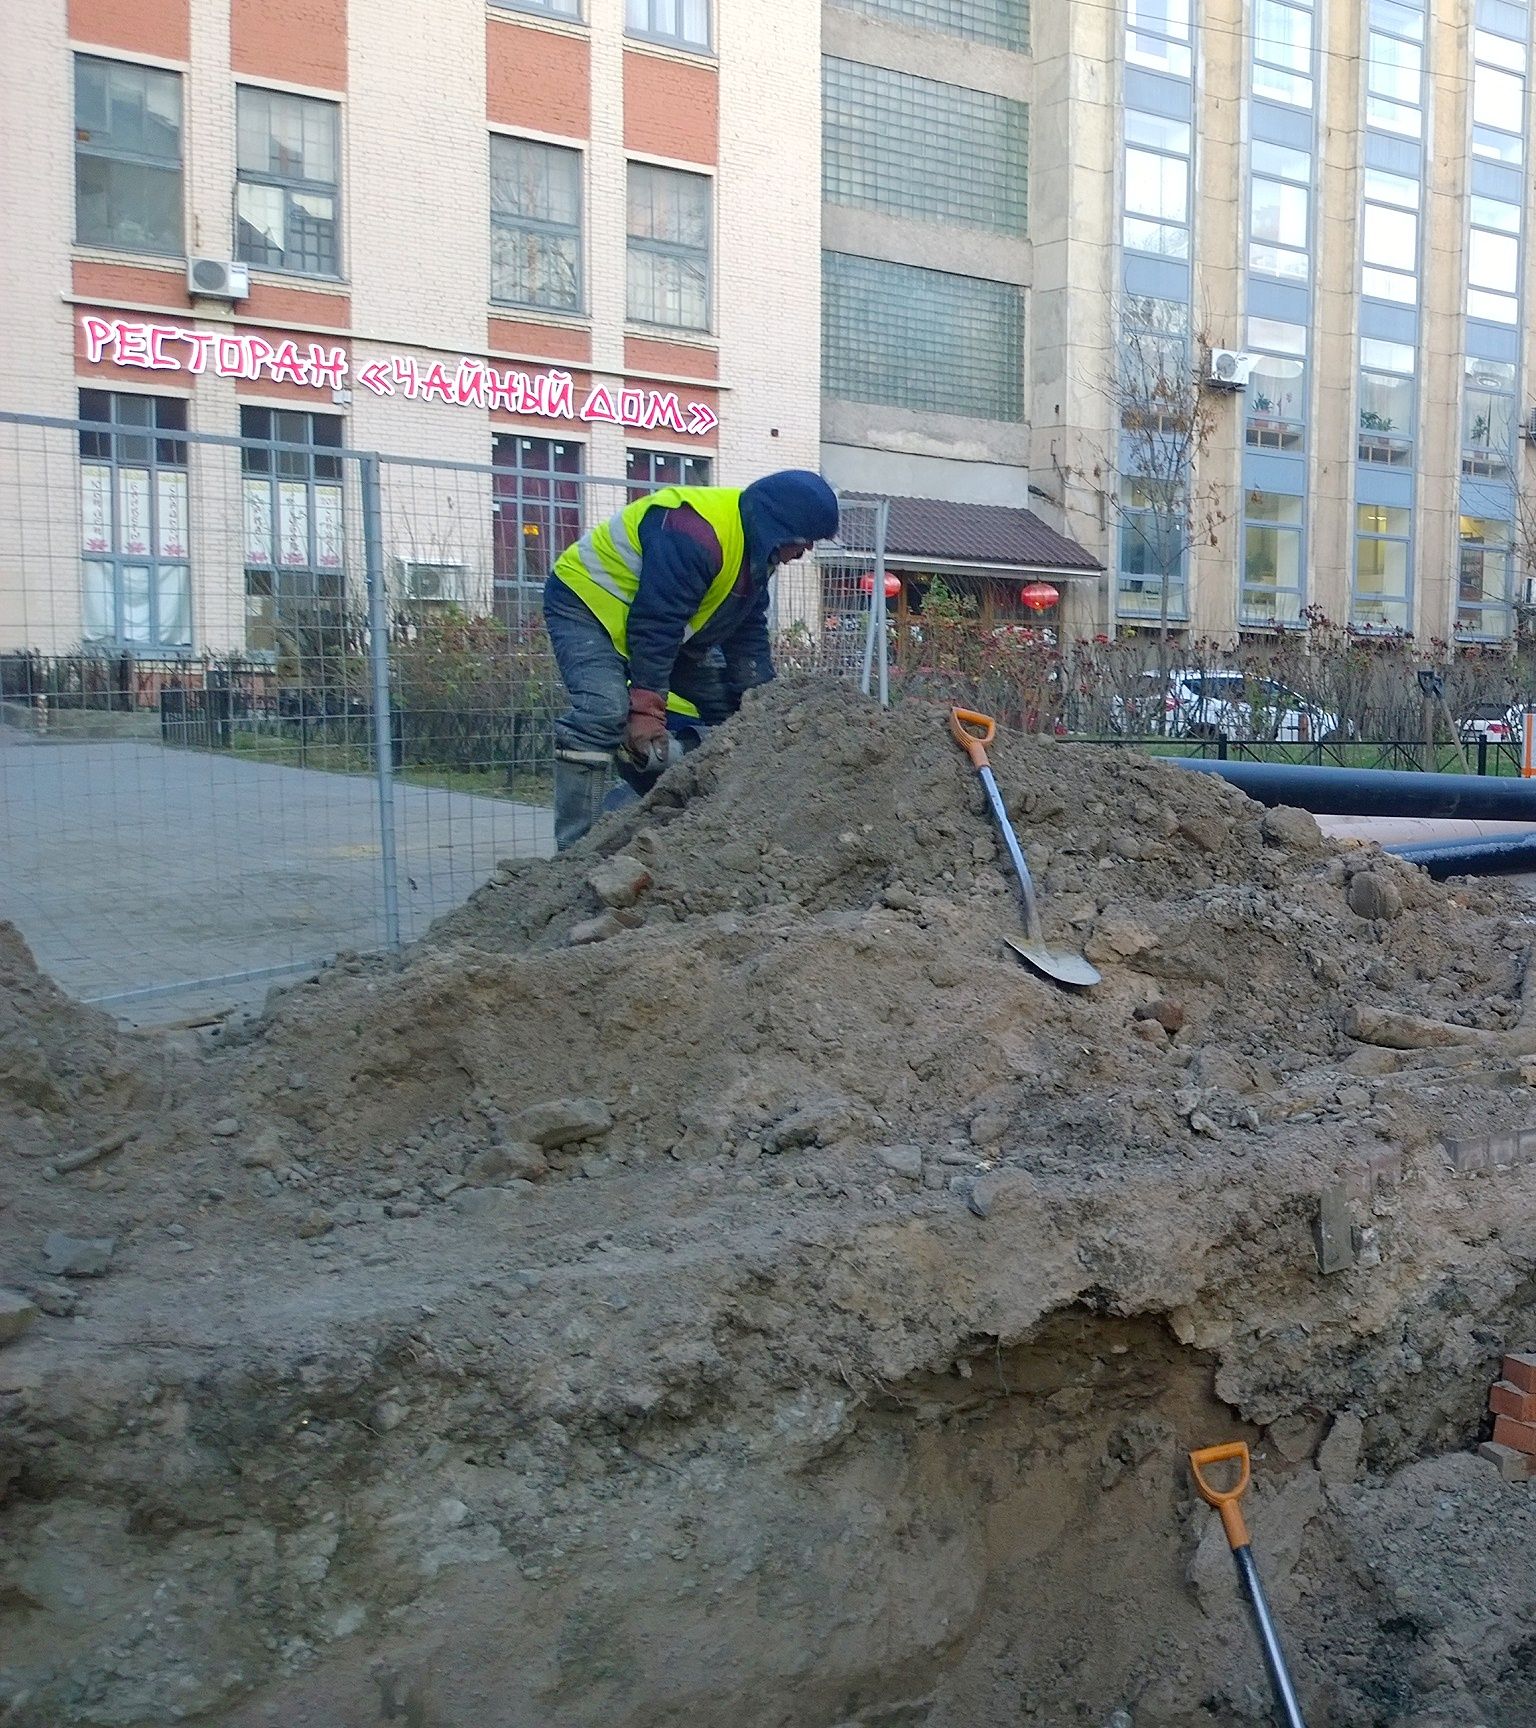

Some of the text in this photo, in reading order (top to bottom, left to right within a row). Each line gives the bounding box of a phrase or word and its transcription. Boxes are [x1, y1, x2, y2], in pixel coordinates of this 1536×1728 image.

[83, 317, 719, 434] РЕСТОРАН «ЧАЙНЫЙ ДОМ»
